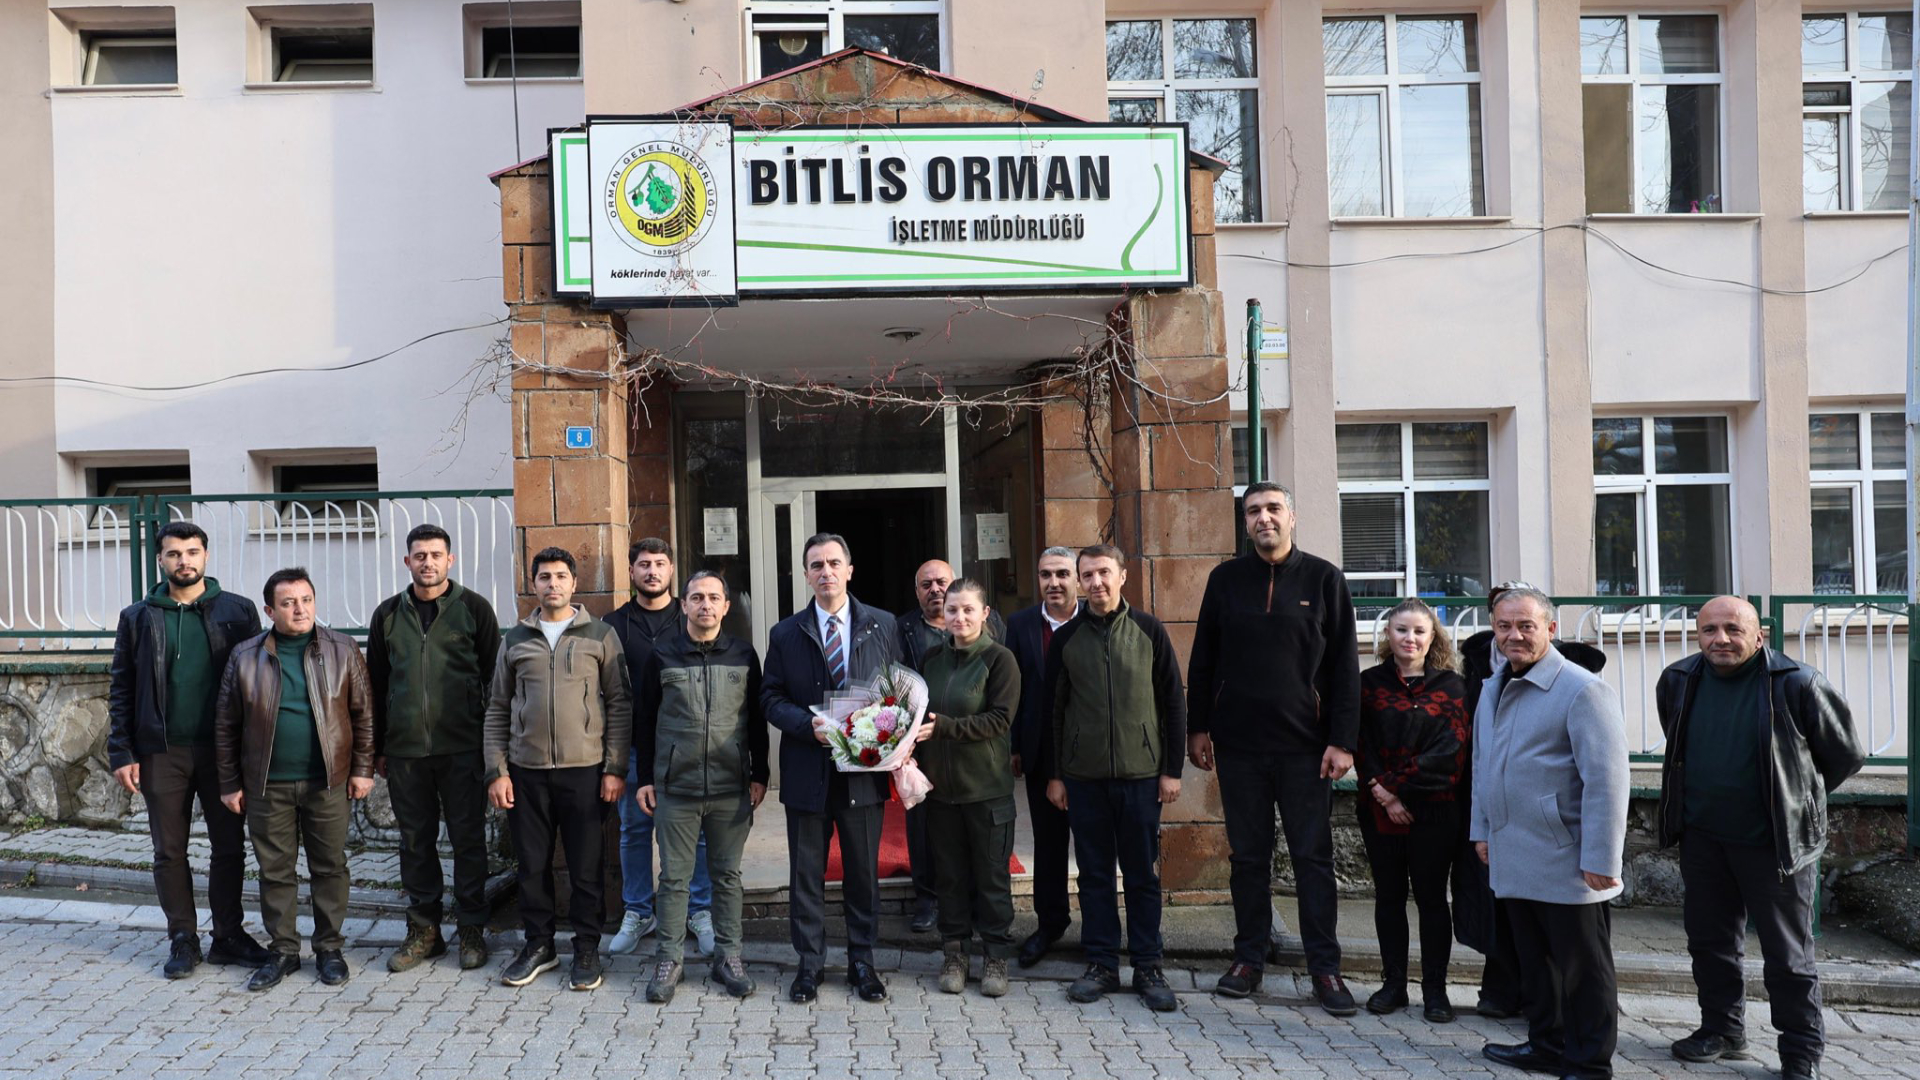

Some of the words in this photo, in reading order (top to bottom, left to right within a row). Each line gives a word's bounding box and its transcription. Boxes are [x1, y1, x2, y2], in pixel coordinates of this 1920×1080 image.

[608, 170, 621, 219] ORMAN
[623, 143, 662, 165] GENEL
[749, 145, 908, 205] BİTLİS
[926, 155, 1111, 203] ORMAN
[637, 218, 664, 239] OGM
[891, 216, 967, 246] İŞLETME
[973, 213, 1085, 242] MÜDÜRLÜĞÜ
[610, 268, 667, 279] köklerinde
[576, 432, 583, 442] 8
